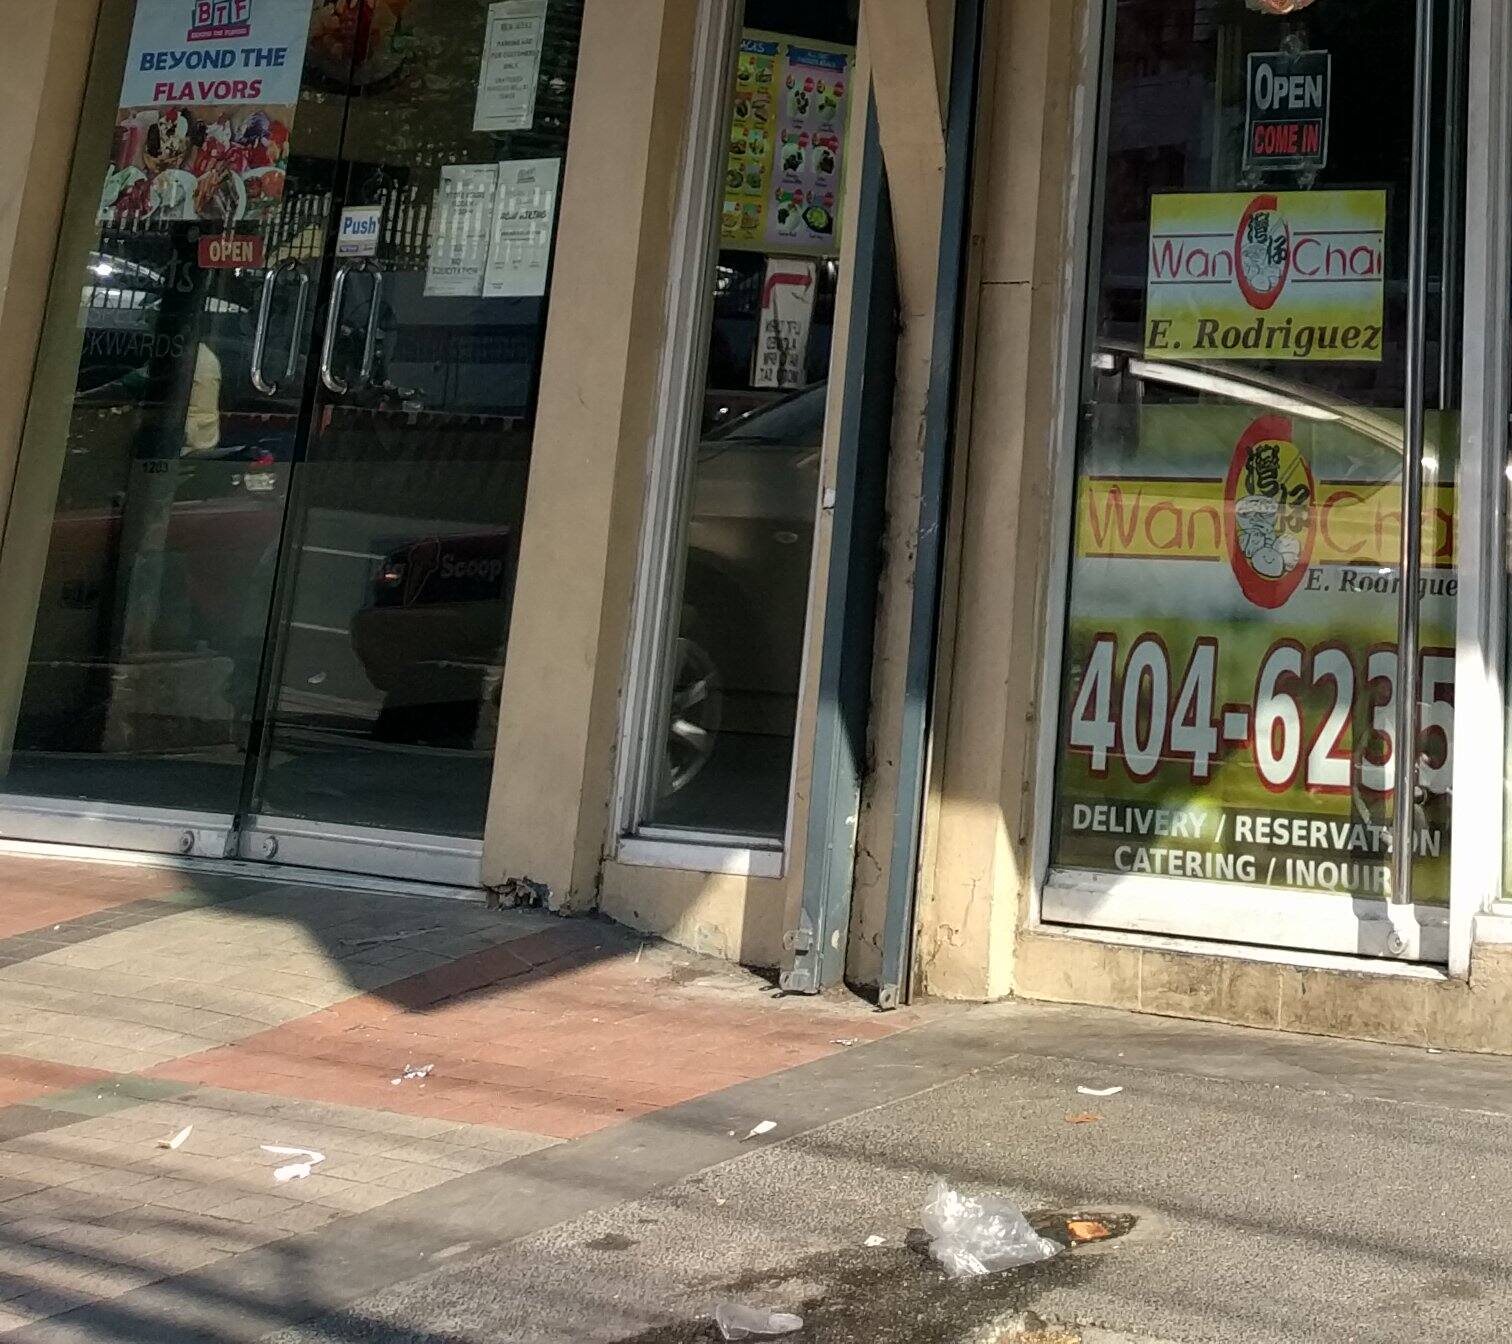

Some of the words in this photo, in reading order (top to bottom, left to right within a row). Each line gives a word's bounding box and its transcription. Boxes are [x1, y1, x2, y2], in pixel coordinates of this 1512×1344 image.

[139, 48, 238, 72] BEYOND
[240, 46, 289, 68] THE
[152, 79, 263, 102] FLAVORS
[1254, 62, 1323, 112] OPEN
[1254, 121, 1298, 157] COME
[1300, 119, 1320, 152] IN
[343, 216, 377, 235] Push
[208, 240, 254, 263] OPEN
[1152, 239, 1233, 279] Wan
[1292, 237, 1382, 276] Chai
[1147, 319, 1182, 350] E.
[1193, 317, 1382, 358] Rodriguez
[1087, 482, 1223, 551] Wan
[1304, 568, 1331, 593] E.
[1068, 632, 1458, 798] 404-6235
[1072, 803, 1207, 837] DELIVERY
[1114, 844, 1256, 882] CATERING
